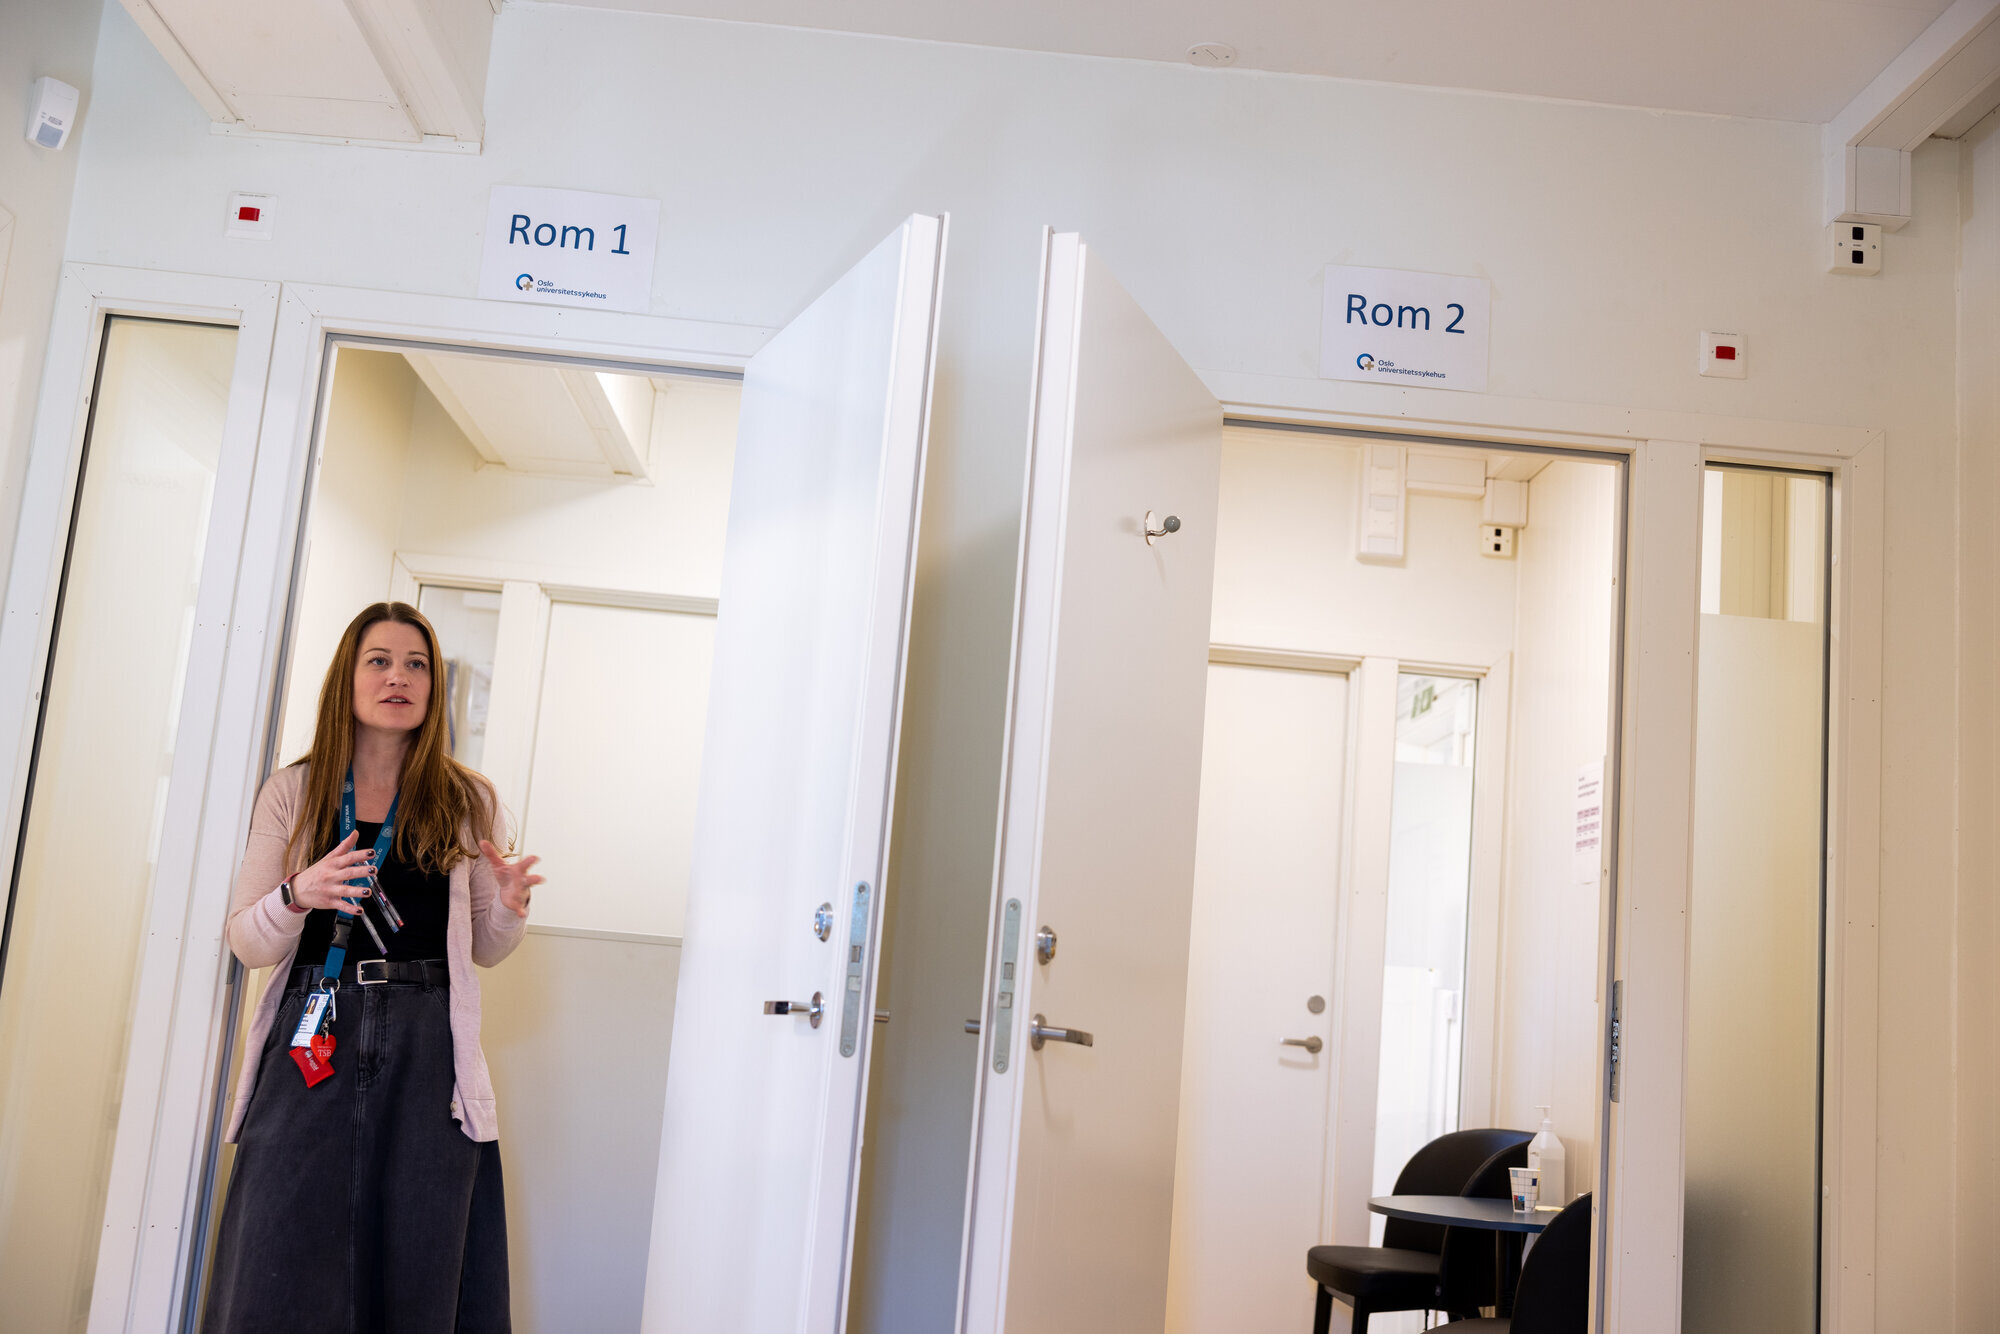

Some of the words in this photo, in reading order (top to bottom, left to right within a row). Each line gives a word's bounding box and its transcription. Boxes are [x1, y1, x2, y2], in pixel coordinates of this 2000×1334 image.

[509, 214, 594, 251] Rom
[611, 224, 630, 255] 1
[537, 279, 554, 287] Oslo
[536, 287, 607, 299] universitetssykehus
[1346, 294, 1430, 330] Rom
[1445, 303, 1465, 334] 2
[1378, 359, 1394, 367] Oslo
[1378, 366, 1446, 379] universitetssykehus
[318, 1049, 332, 1057] TSB
